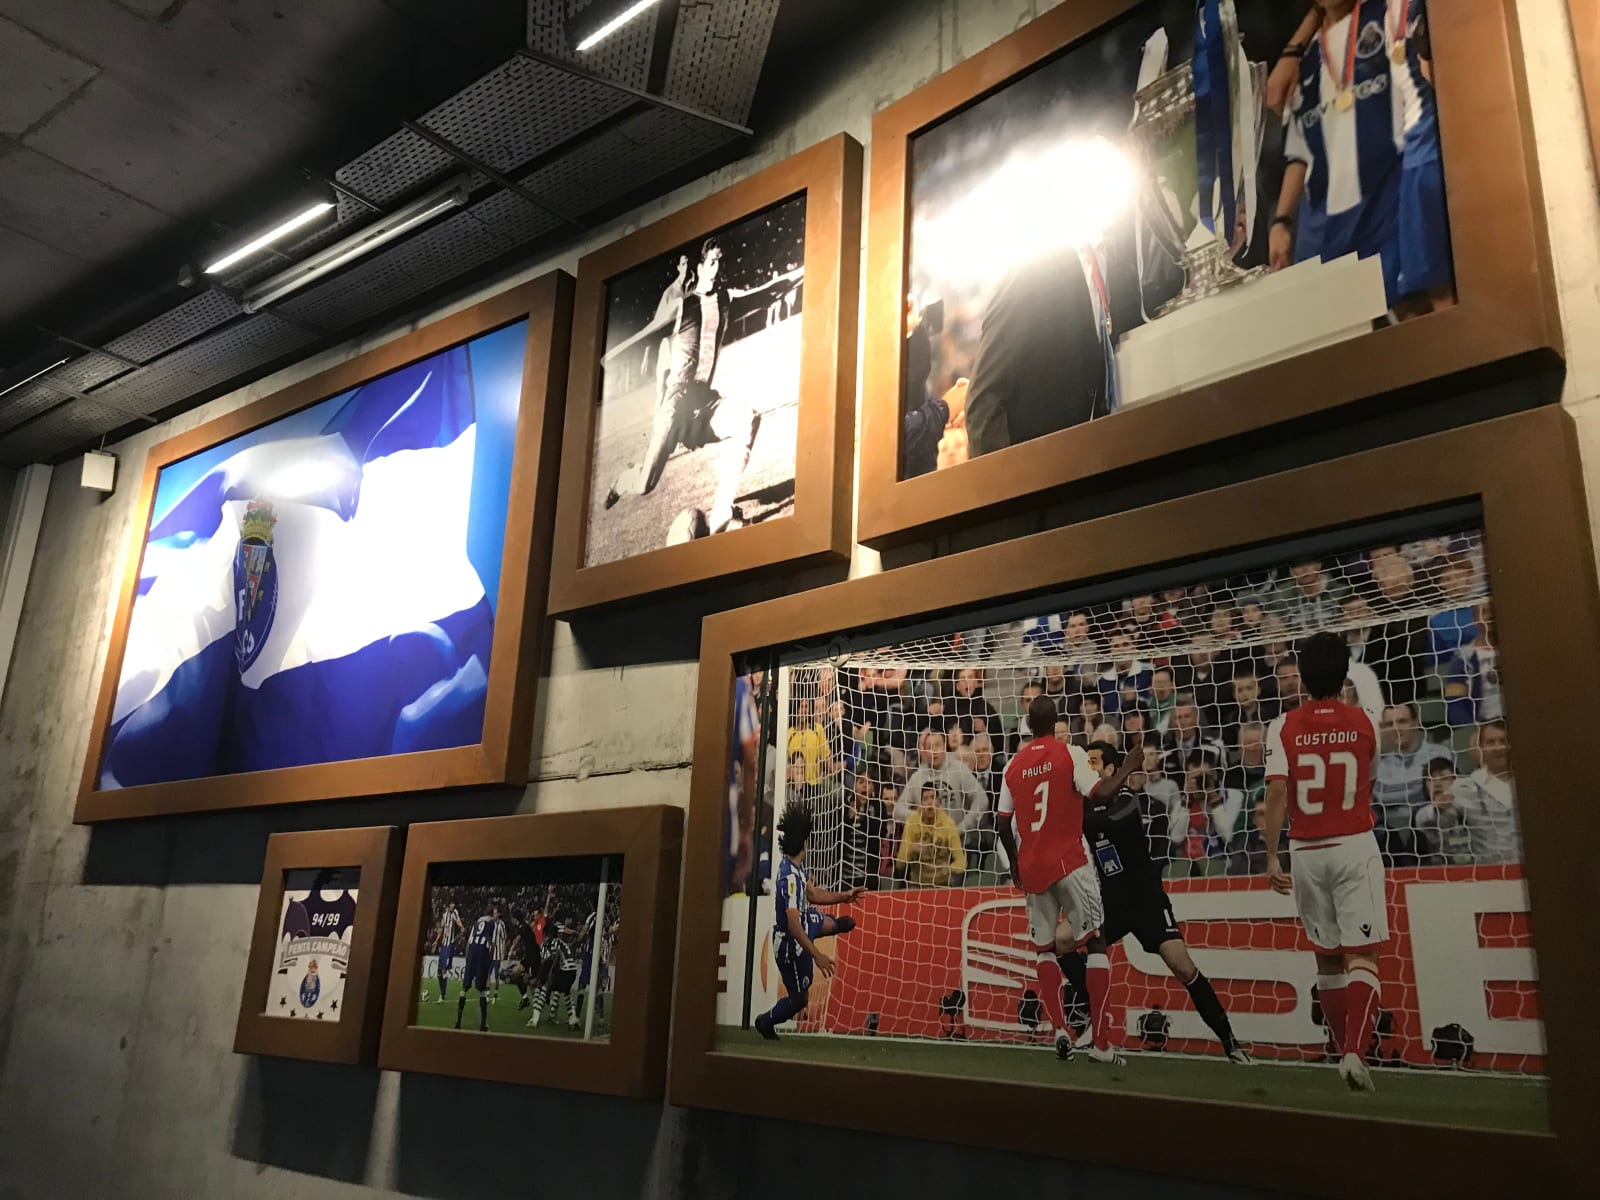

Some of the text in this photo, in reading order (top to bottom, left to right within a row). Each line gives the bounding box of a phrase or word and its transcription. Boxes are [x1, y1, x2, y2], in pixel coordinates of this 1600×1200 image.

[1295, 728, 1358, 746] CUSTÓDIO
[1022, 761, 1052, 779] PAULÃO
[1296, 751, 1358, 815] 27
[1031, 780, 1050, 832] 3
[311, 912, 340, 928] 94/99
[476, 919, 486, 935] 9
